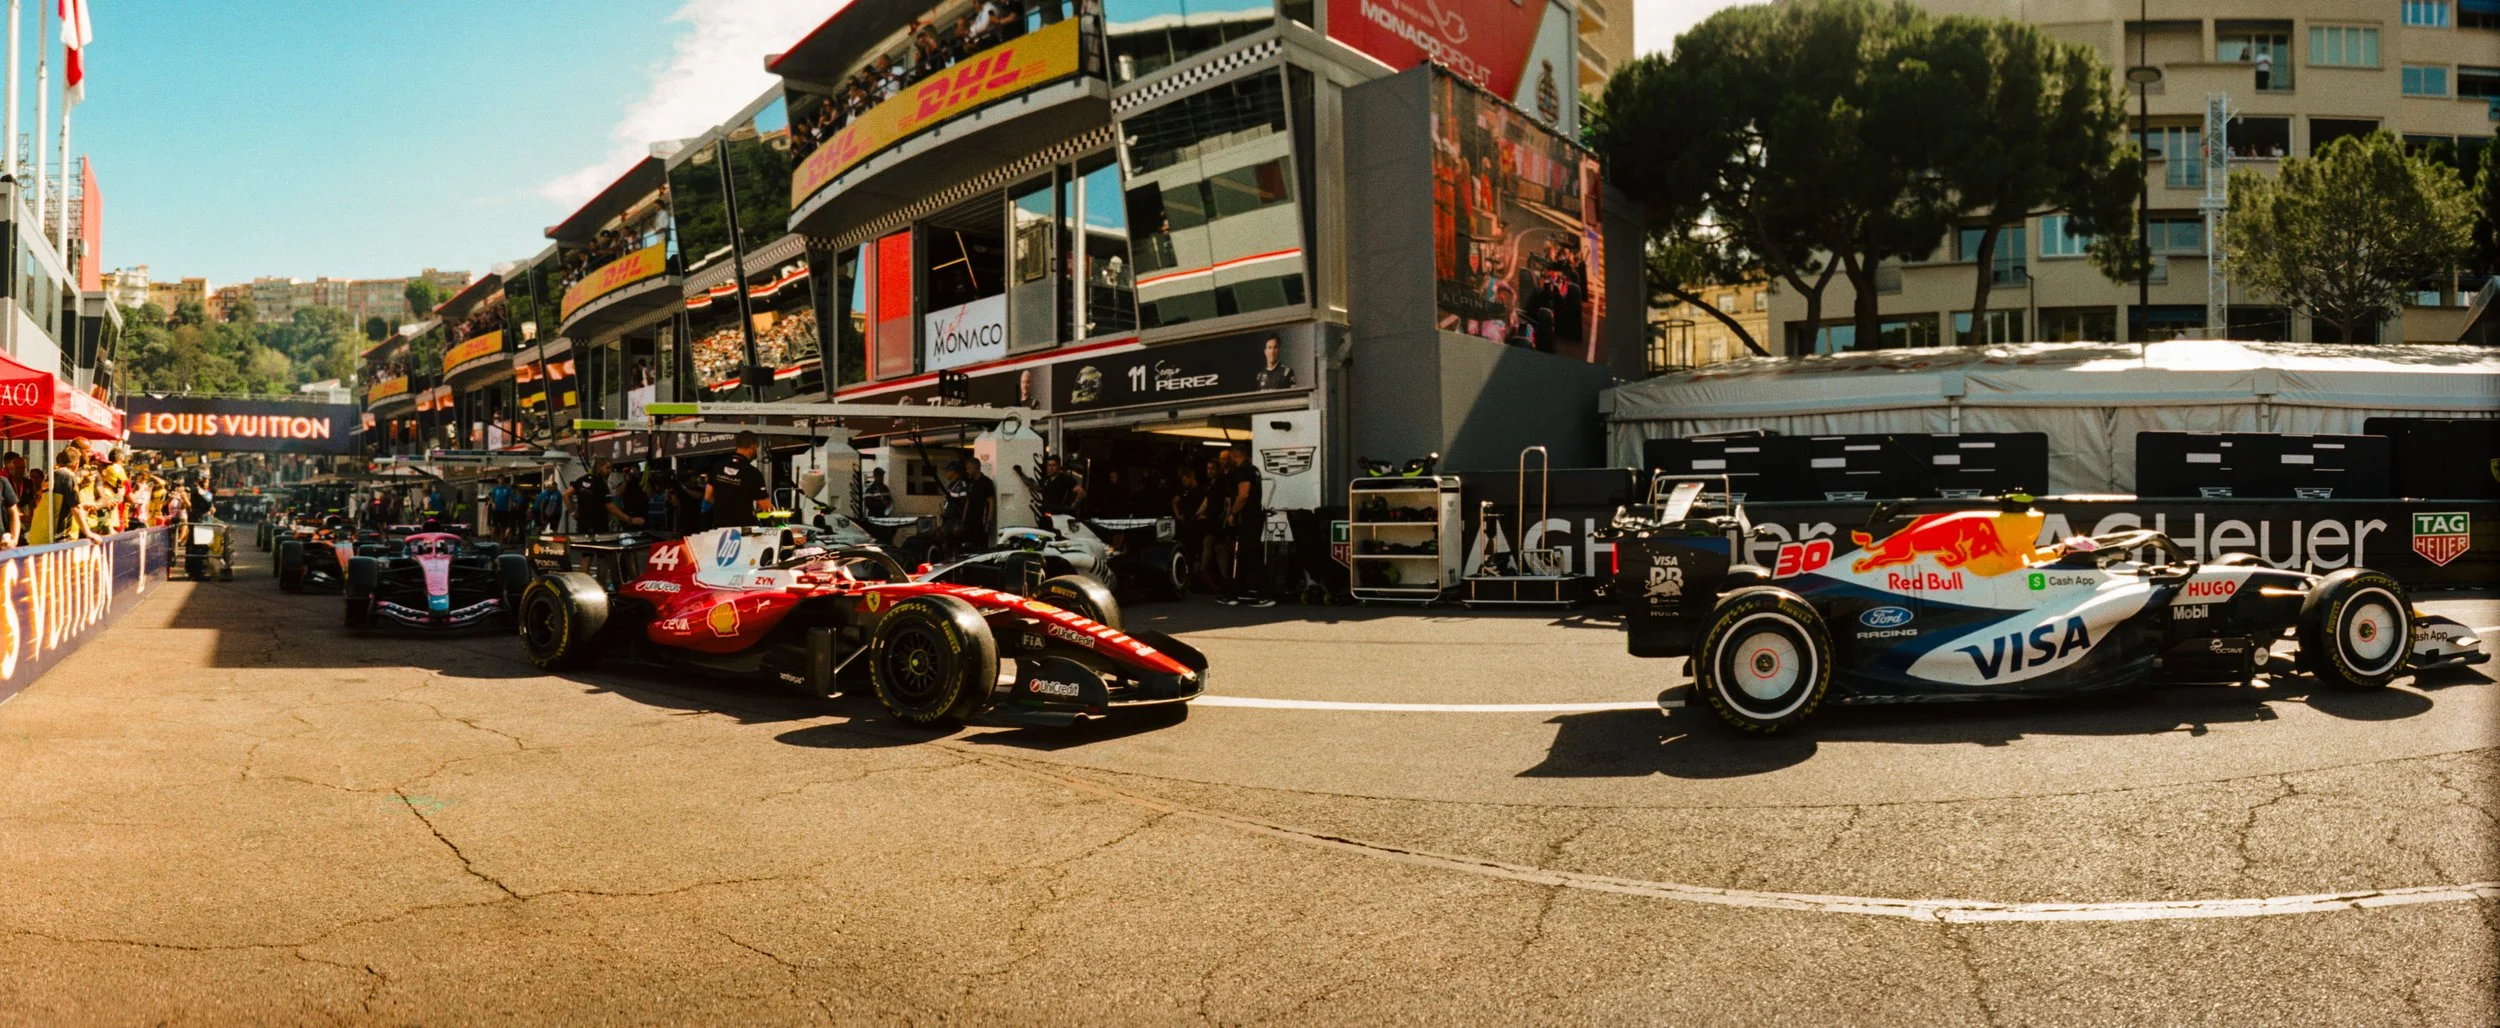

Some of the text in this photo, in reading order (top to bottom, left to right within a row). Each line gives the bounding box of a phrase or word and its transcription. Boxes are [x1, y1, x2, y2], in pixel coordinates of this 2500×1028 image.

[913, 50, 1021, 122] DHL
[933, 323, 1003, 362] MONACO
[1128, 365, 1219, 392] 11 PEREZ
[143, 412, 331, 439] LOUIS VUITTON
[2417, 515, 2465, 533] TAG
[717, 529, 741, 567] hp
[2416, 537, 2467, 562] HEUER
[649, 545, 681, 571] 44
[1652, 556, 1679, 566] VISA
[1773, 539, 1834, 579] 30
[755, 576, 776, 585] ZYN
[1888, 572, 1964, 590] Red Bull
[2049, 577, 2074, 586] Cash
[2076, 576, 2095, 586] App
[2188, 580, 2236, 596] HUGO
[28, 540, 114, 662] VUITTON
[1870, 609, 1903, 625] Ford
[2173, 605, 2209, 620] Mobil
[1022, 634, 1043, 648] FIA
[1857, 629, 1918, 639] RACING
[2413, 630, 2448, 642] ash App
[1955, 615, 2091, 680] VISA
[1040, 683, 1079, 697] UniCredit
